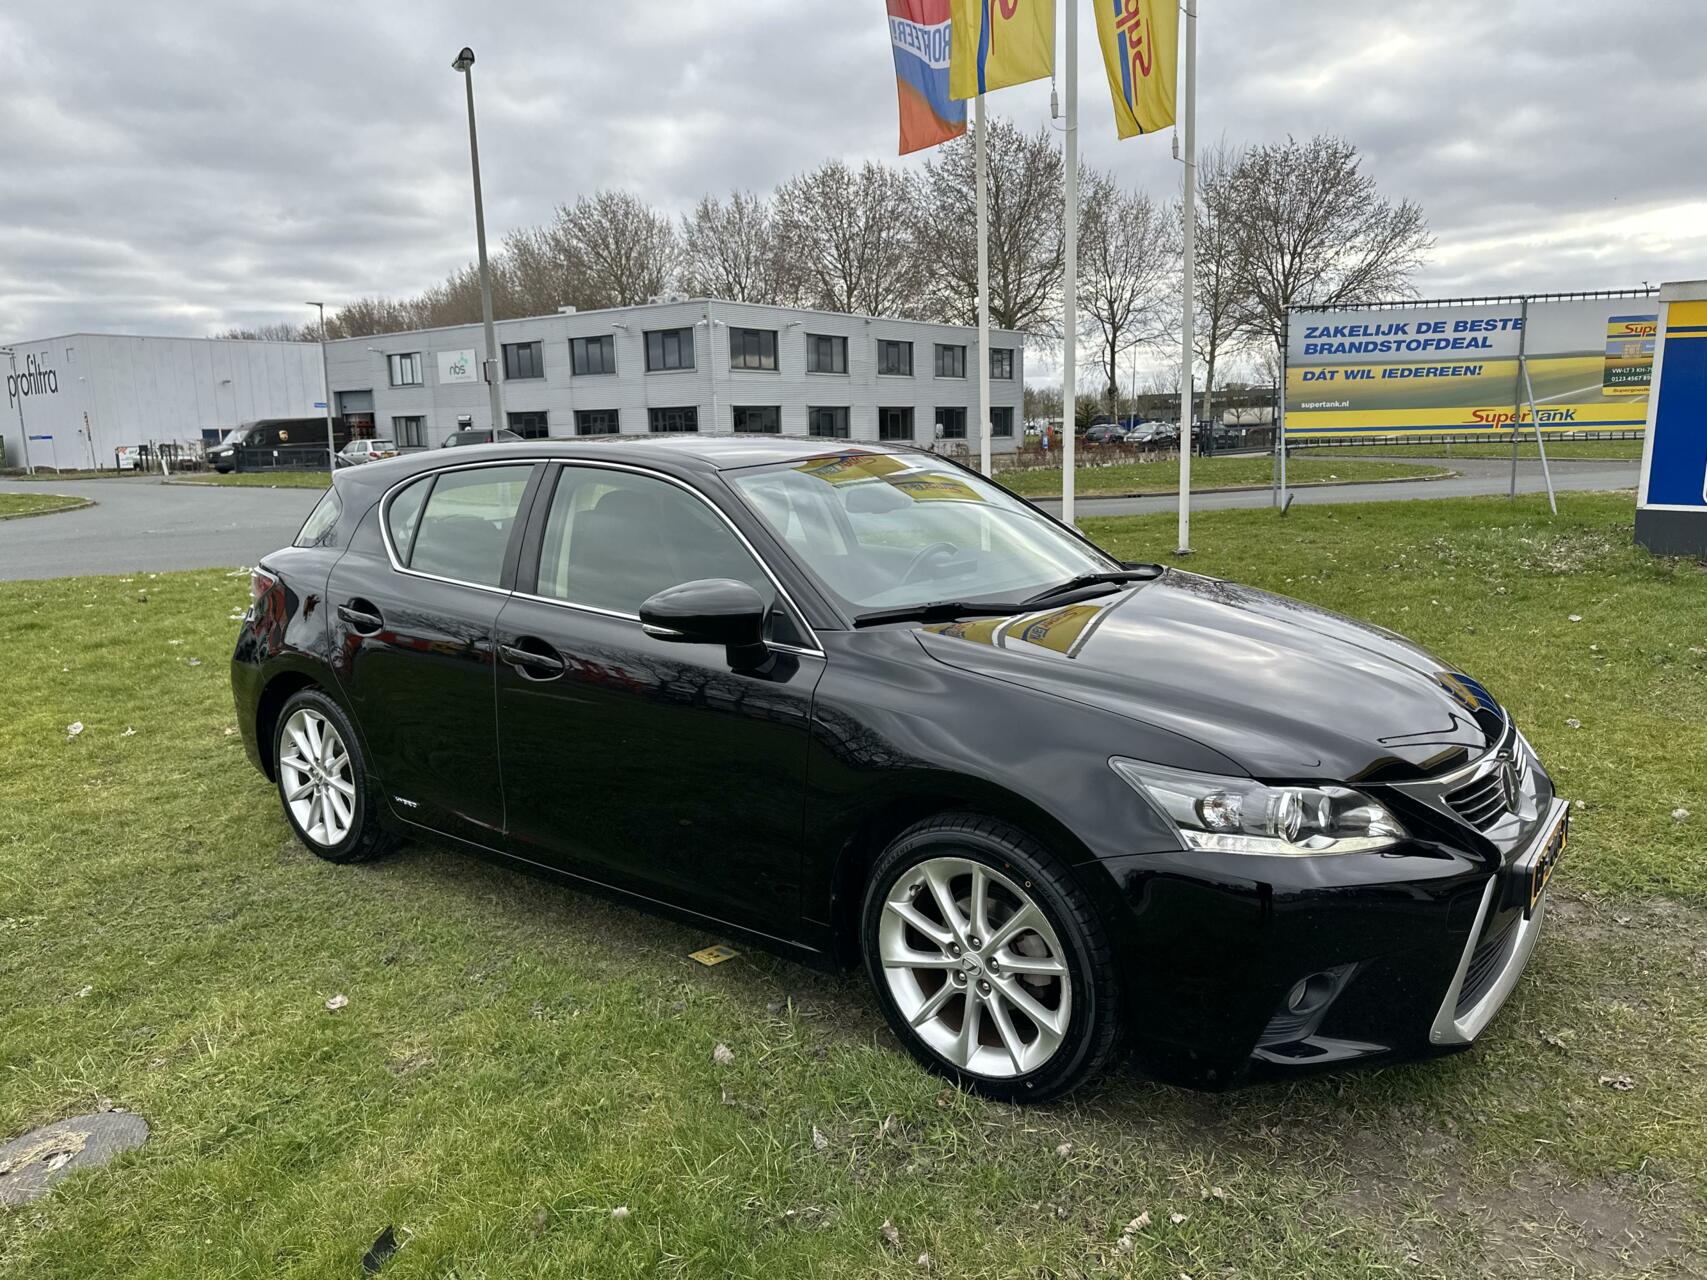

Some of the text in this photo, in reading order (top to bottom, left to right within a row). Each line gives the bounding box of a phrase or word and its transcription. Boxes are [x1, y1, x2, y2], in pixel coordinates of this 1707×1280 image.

[1304, 317, 1525, 339] ZAKELIJK DE BESTE
[1303, 337, 1493, 355] BRANDSTOFDEAL
[449, 362, 466, 376] nbs
[1302, 365, 1484, 382] DÁT WIL IEDEREEN!
[6, 353, 59, 409] profiltra
[1300, 400, 1350, 409] supertank.nl
[1461, 409, 1576, 429] SuperTank
